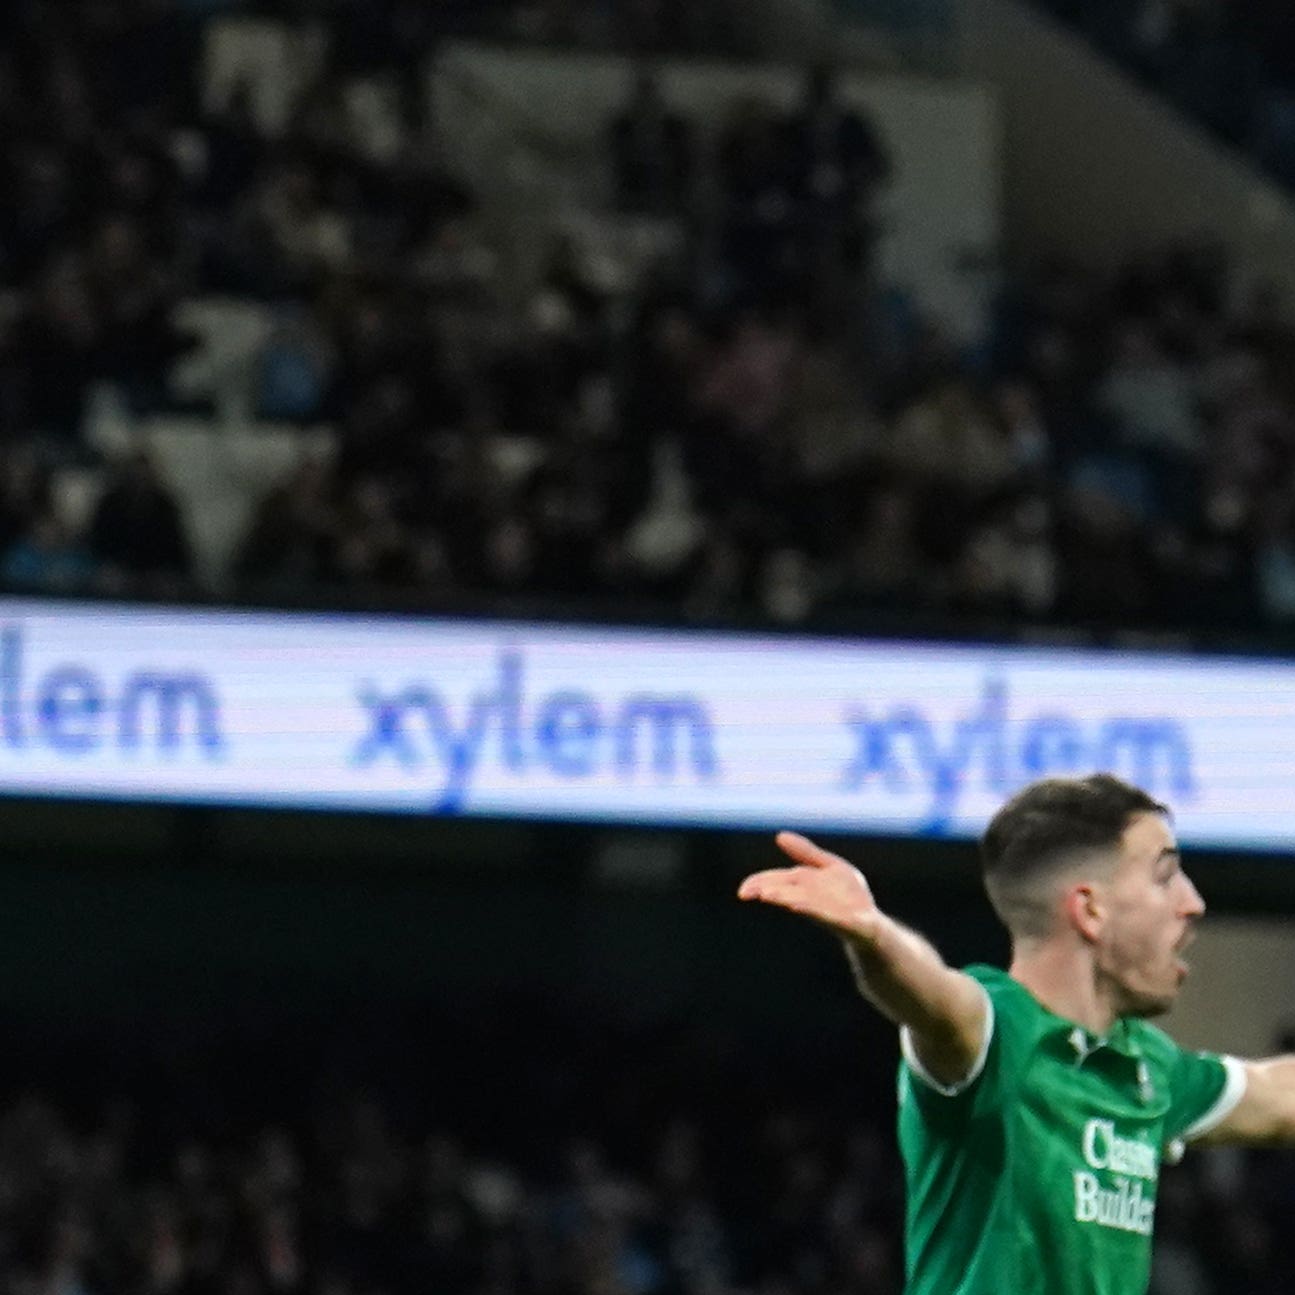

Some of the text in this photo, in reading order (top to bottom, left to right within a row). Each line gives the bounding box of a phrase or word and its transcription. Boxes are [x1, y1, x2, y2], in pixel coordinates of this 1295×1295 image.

[0, 620, 228, 764] lem
[352, 644, 722, 814] xylem
[836, 672, 1195, 836] xylem
